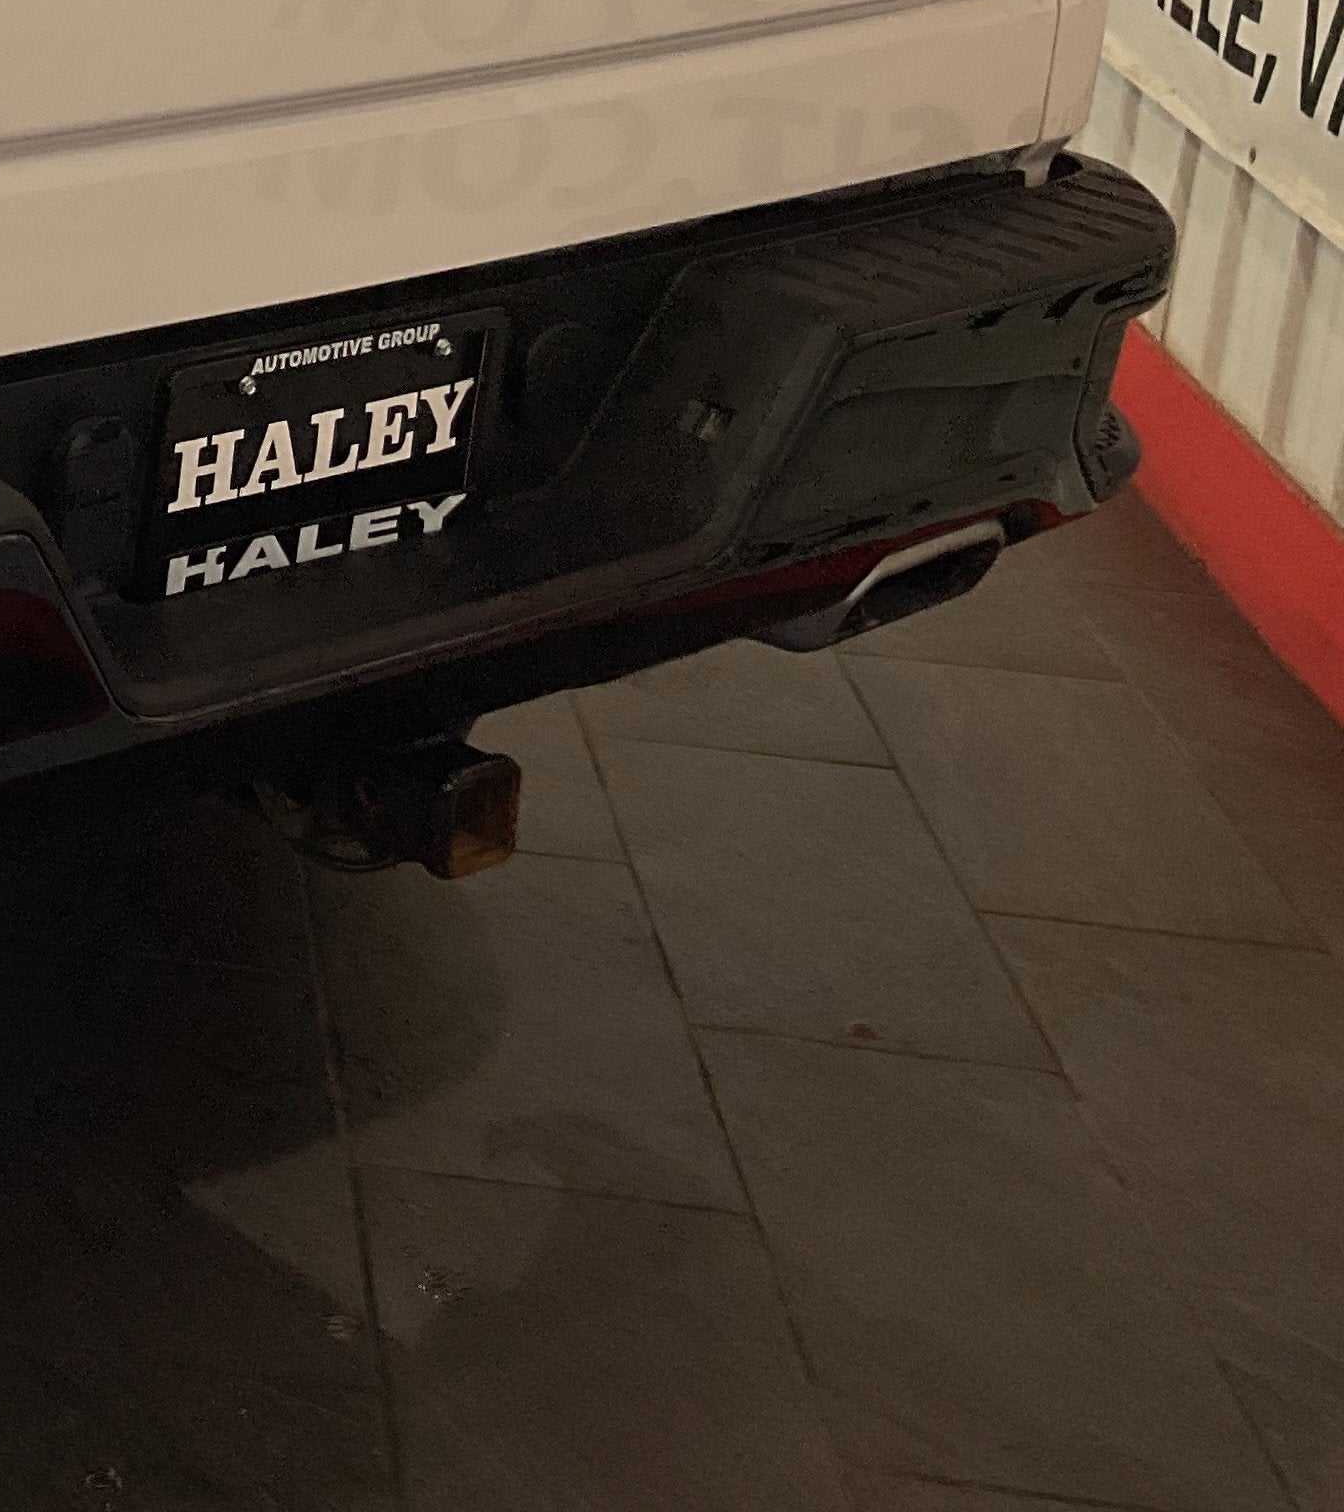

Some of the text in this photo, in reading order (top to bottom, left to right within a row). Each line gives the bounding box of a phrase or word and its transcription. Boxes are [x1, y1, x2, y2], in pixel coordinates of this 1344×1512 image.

[250, 323, 441, 377] AUTOMOTIVE GROUP
[167, 377, 475, 514] HALEY
[165, 492, 468, 597] HALEY
